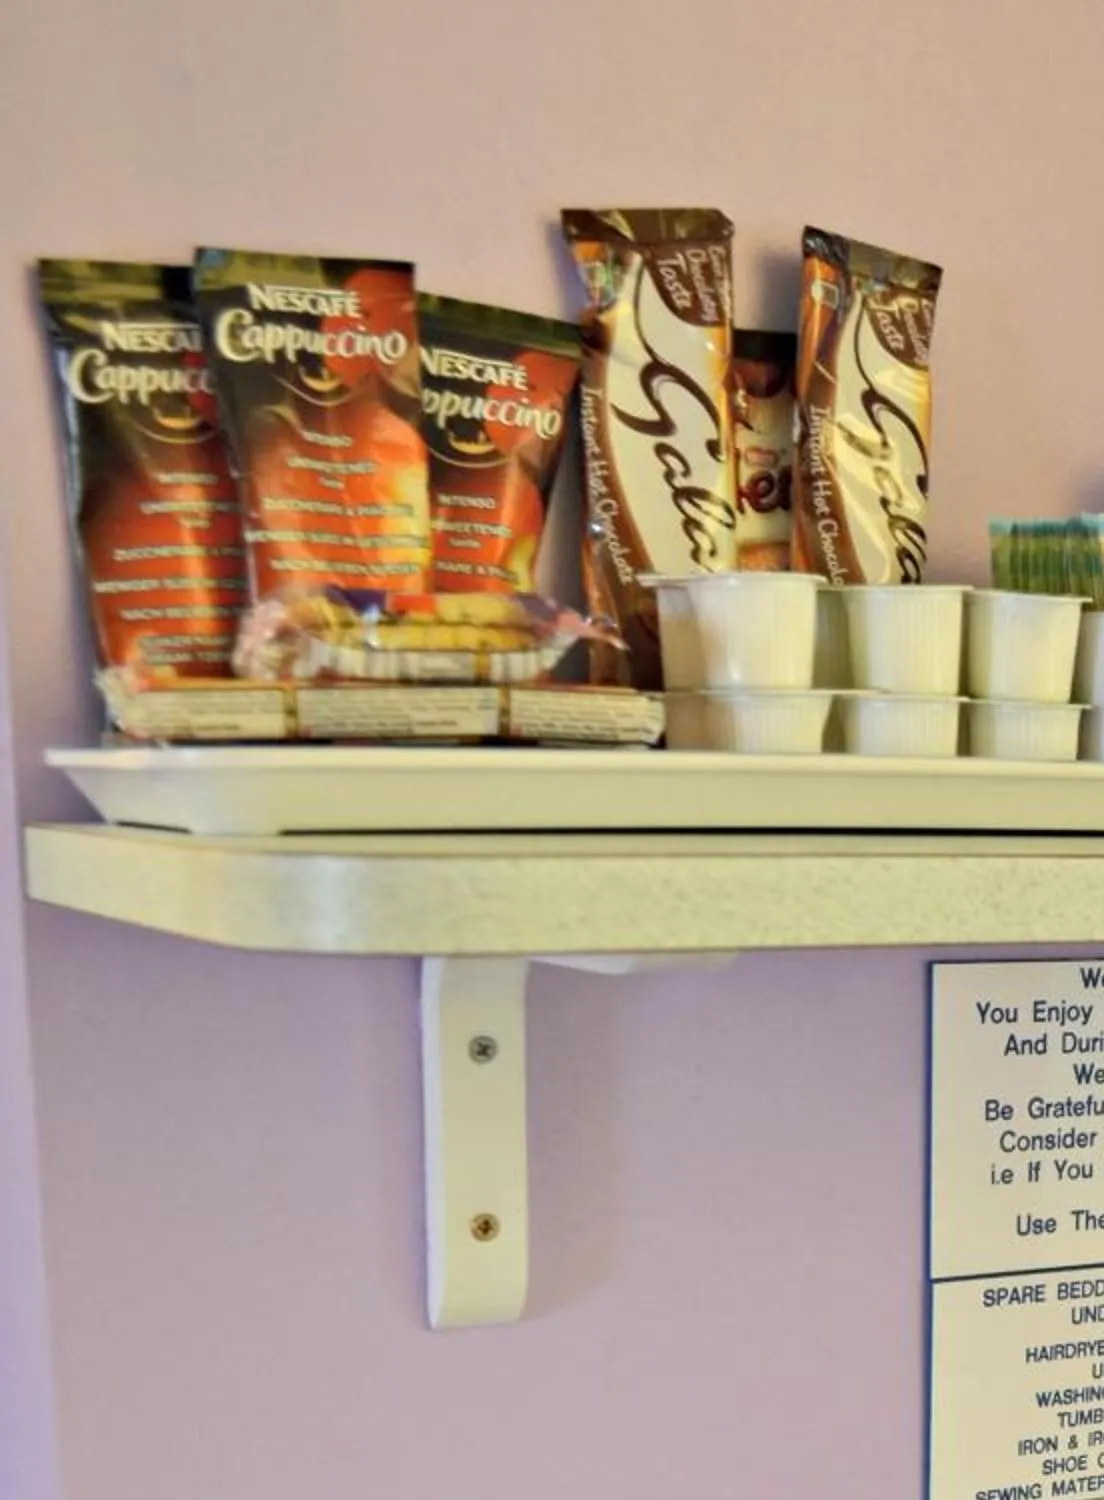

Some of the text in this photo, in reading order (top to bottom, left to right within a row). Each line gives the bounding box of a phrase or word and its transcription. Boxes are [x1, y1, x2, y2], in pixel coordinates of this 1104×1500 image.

[247, 281, 362, 319] NESCAFÉ
[101, 320, 202, 353] NESCA
[215, 308, 407, 365] Cappuccino
[70, 348, 216, 406] Cappucc
[420, 345, 530, 391] NESCAFÉ
[811, 479, 834, 516] Hot
[817, 518, 849, 588] Chocola
[976, 1001, 1019, 1024] You
[1033, 1001, 1093, 1026] Enjoy
[1004, 1034, 1047, 1055] And
[985, 1099, 1013, 1120] Be
[1000, 1131, 1096, 1152] Consider
[1028, 1162, 1040, 1182] If
[1055, 1159, 1093, 1181] You
[1017, 1214, 1056, 1236] Use
[983, 1285, 1046, 1306] SPARE
[1018, 1435, 1057, 1456] IRON
[1068, 1434, 1078, 1449] &
[1042, 1455, 1087, 1475] SHOE
